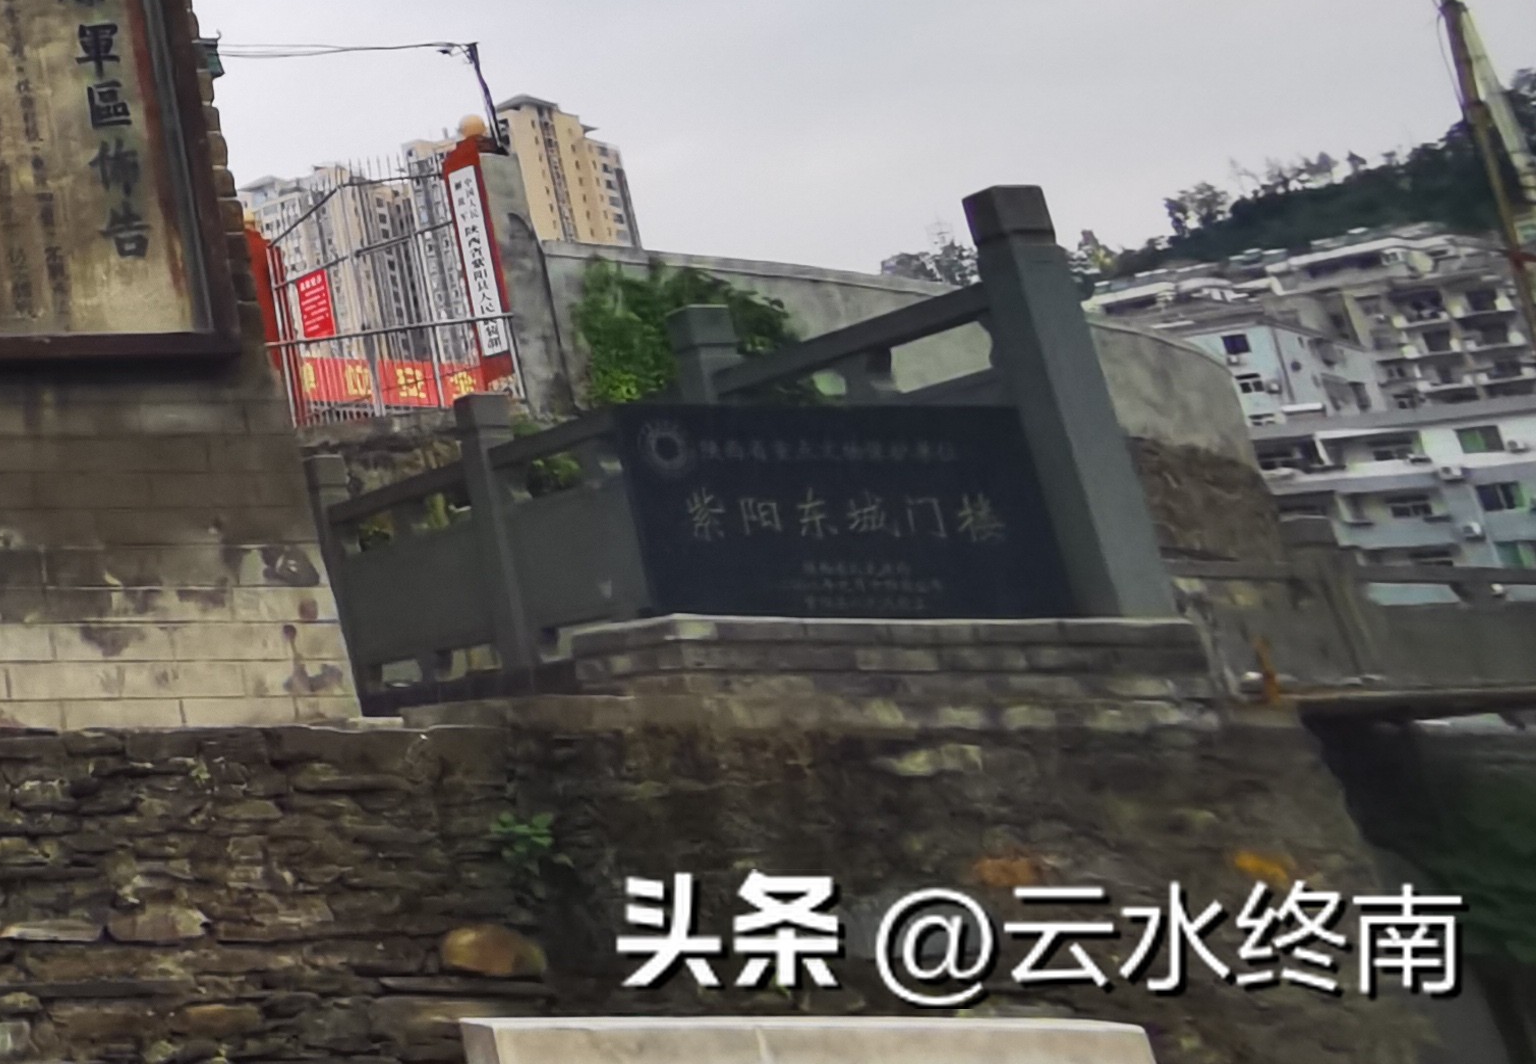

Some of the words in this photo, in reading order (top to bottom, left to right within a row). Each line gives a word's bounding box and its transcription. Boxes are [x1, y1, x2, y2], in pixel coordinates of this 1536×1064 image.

[685, 486, 1009, 543] 紫阳东城门楼
